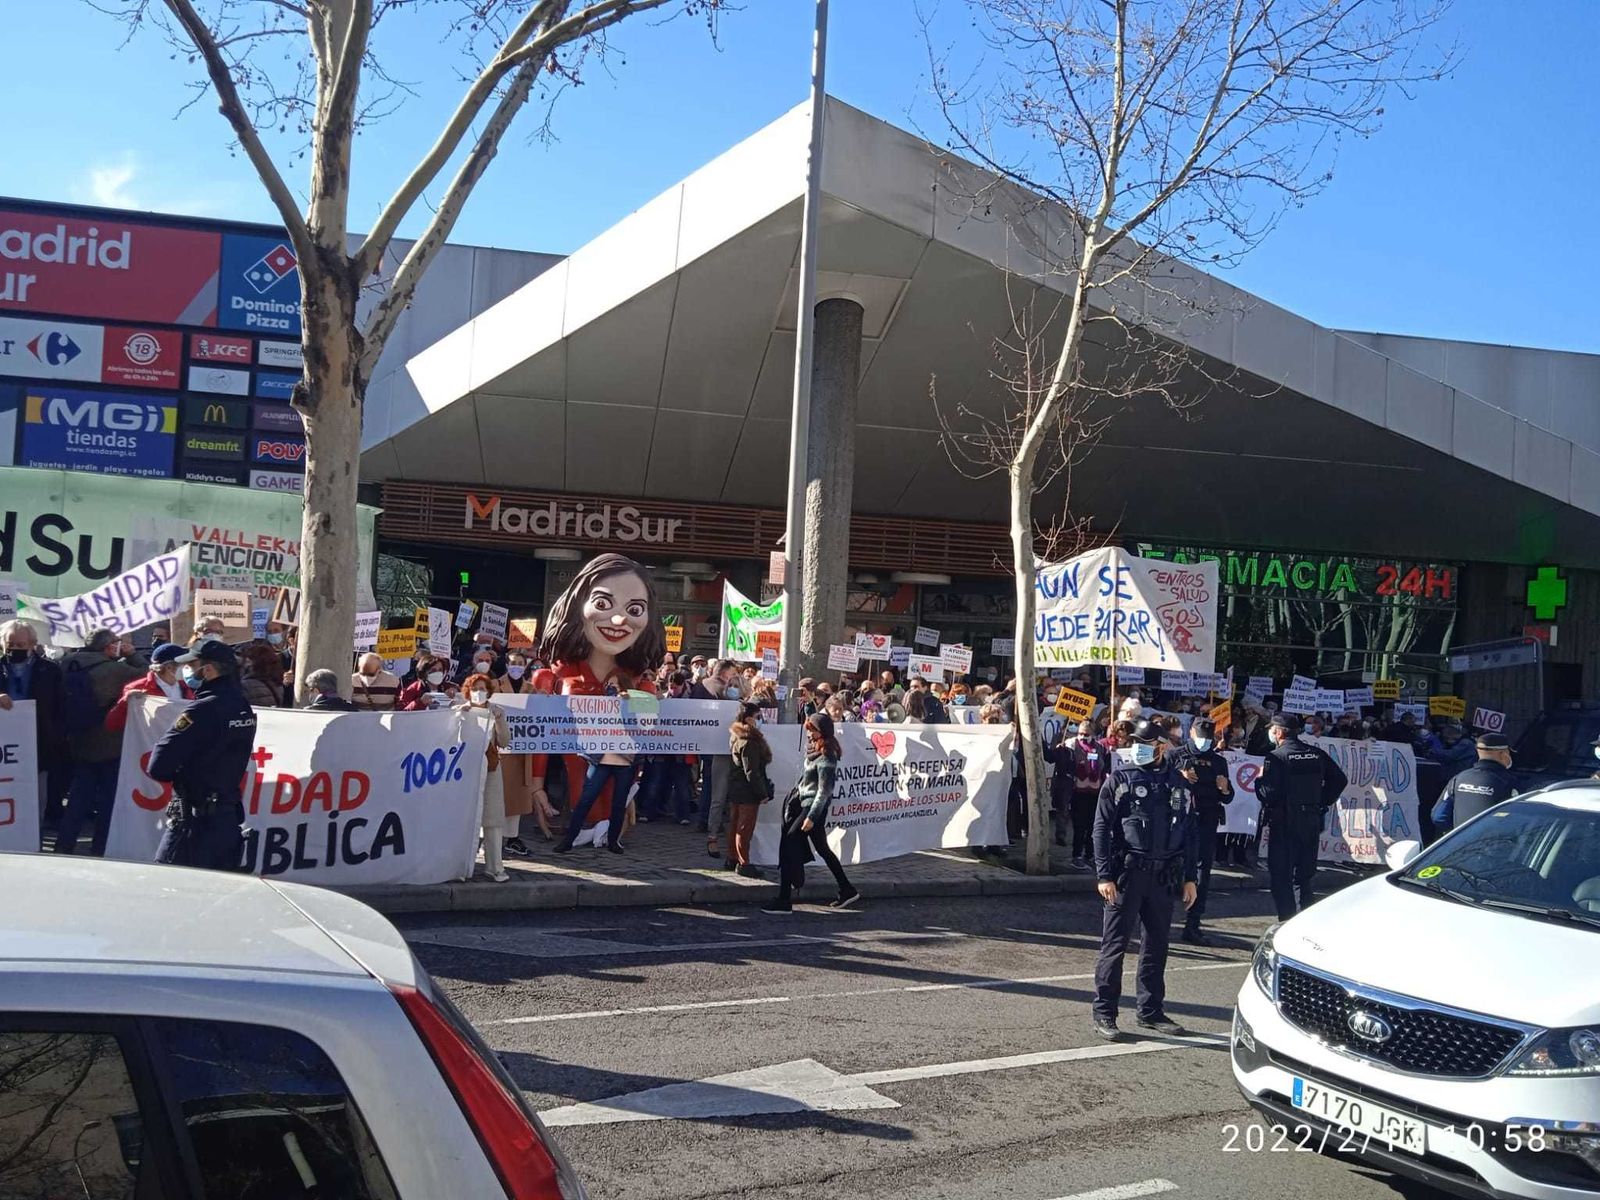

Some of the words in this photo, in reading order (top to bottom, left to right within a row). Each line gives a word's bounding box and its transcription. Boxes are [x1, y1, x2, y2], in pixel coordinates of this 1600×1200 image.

[246, 313, 290, 329] Pizza
[134, 343, 151, 355] 18
[213, 344, 248, 357] KFC
[66, 429, 137, 449] tiendas
[187, 438, 239, 452] dreamfit
[256, 475, 300, 490] GAME
[40, 556, 179, 622] SANIDAD
[1098, 566, 1133, 600] SE
[1375, 565, 1451, 599] 24H
[1170, 588, 1210, 603] SALUD
[1162, 607, 1200, 628] SOS
[535, 716, 588, 725] SANITARIOS
[590, 717, 596, 725] Y
[598, 717, 638, 726] SOCIALES
[640, 718, 658, 726] QUE
[660, 719, 719, 727] NECESITAMOS
[1474, 710, 1502, 729] NO
[563, 729, 608, 737] MALTRATO
[610, 729, 674, 737] INSTITUCIONAL
[541, 742, 557, 751] DE
[561, 742, 597, 751] SALUD
[600, 742, 615, 751] DE
[619, 742, 701, 752] CARABANCHEL
[401, 741, 465, 794] 100%
[831, 806, 845, 817] LA
[847, 799, 904, 816] REAPERTURA
[917, 794, 933, 805] LOS
[935, 792, 962, 804] SUAP
[1352, 1019, 1383, 1038] KIA
[1305, 1086, 1364, 1127] 7170
